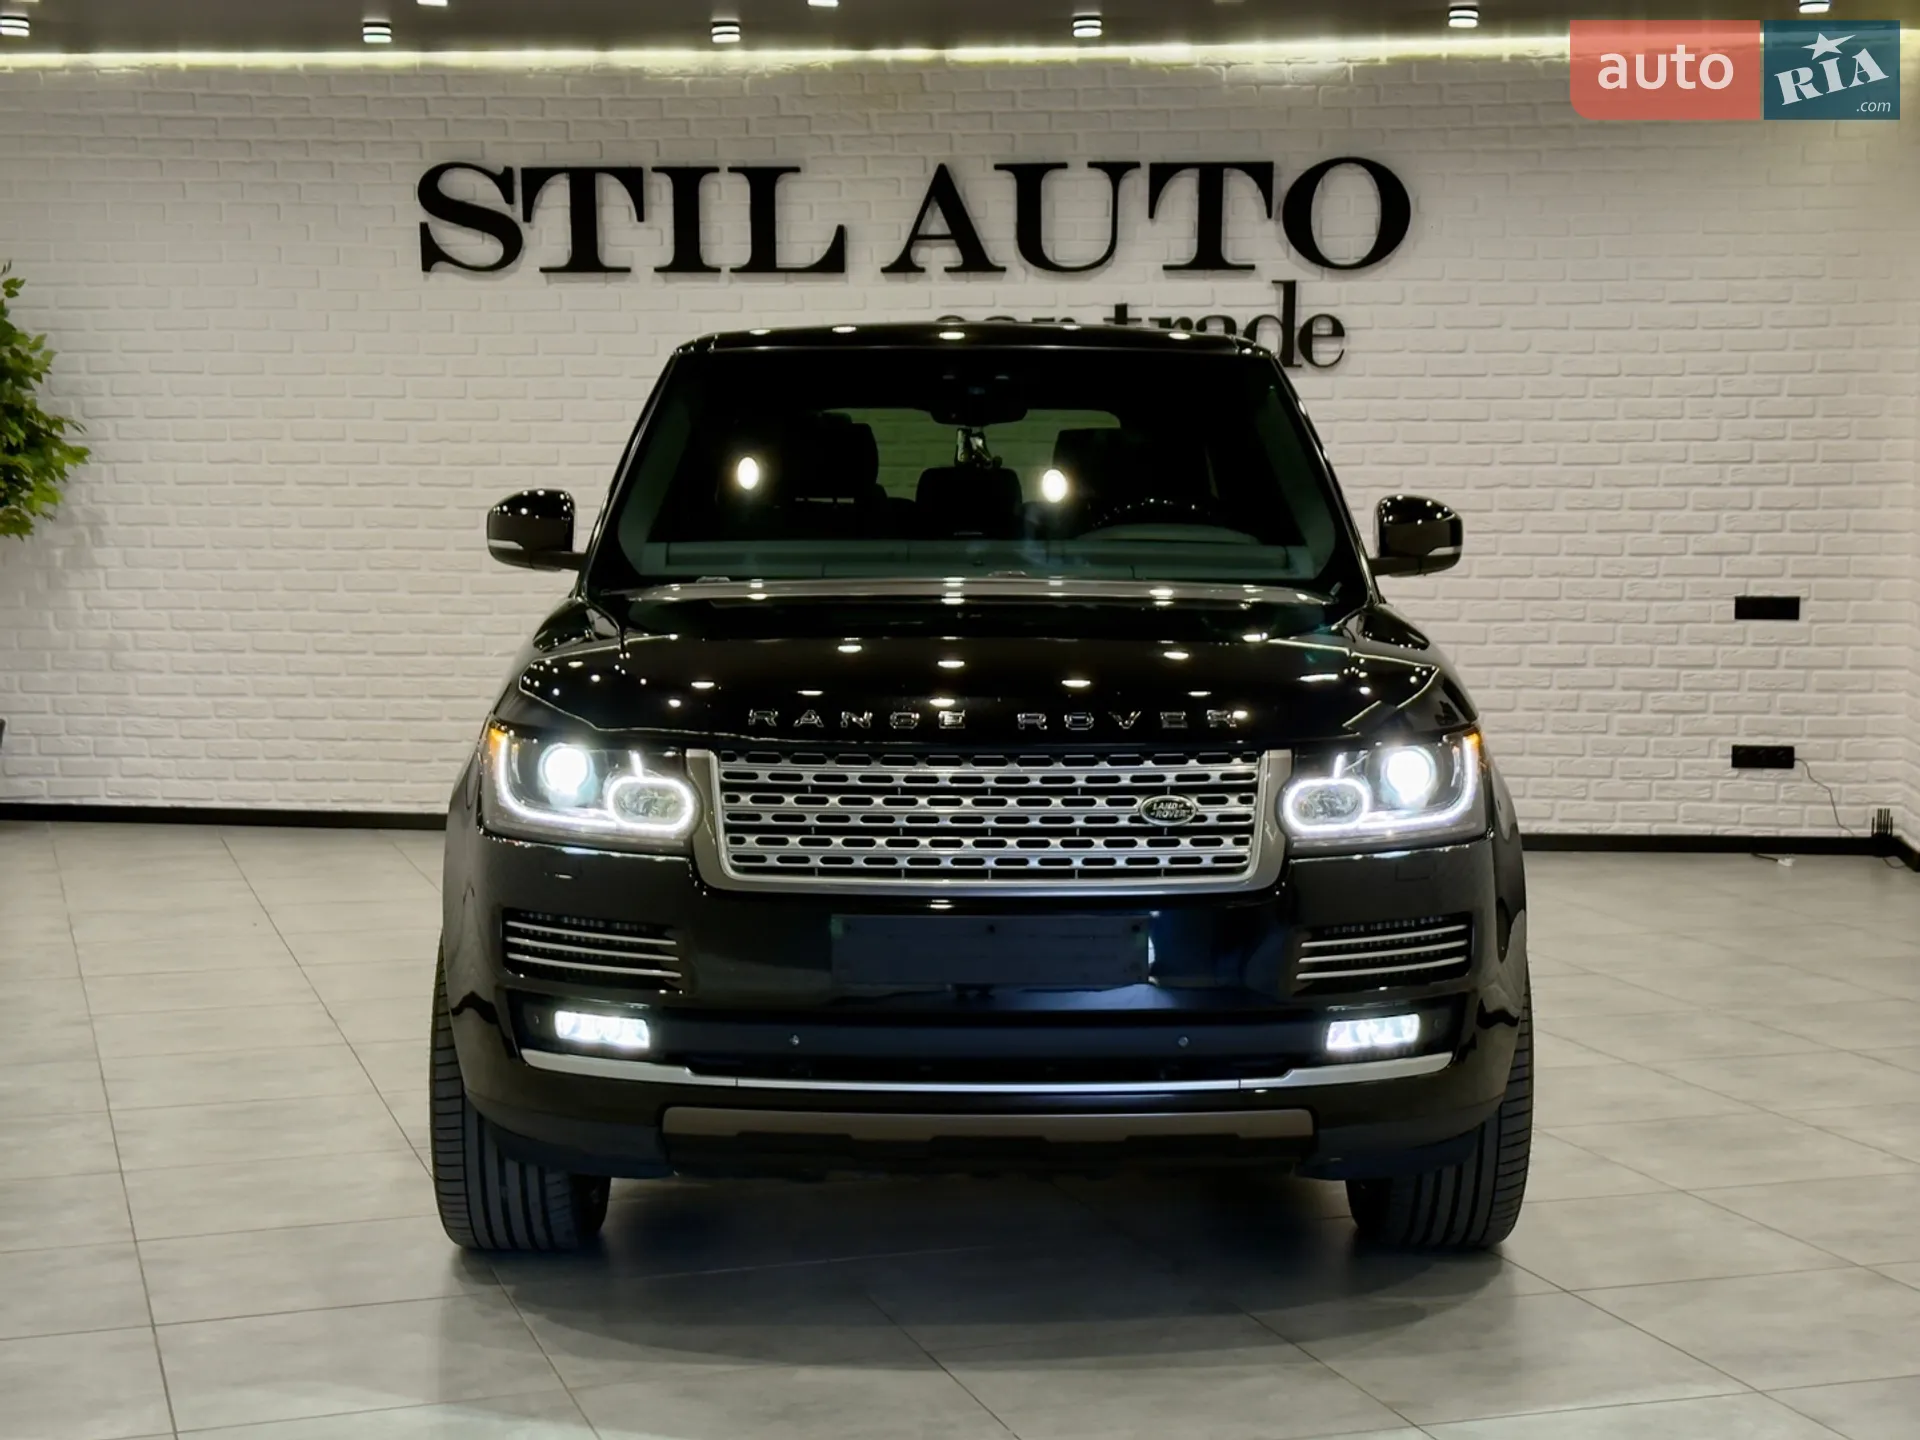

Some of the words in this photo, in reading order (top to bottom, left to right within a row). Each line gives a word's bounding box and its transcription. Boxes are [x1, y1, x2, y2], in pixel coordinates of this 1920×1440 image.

[417, 161, 846, 274] STIL
[880, 156, 1411, 274] AUTO
[748, 708, 966, 730] RANGE
[1016, 708, 1238, 731] ROVER
